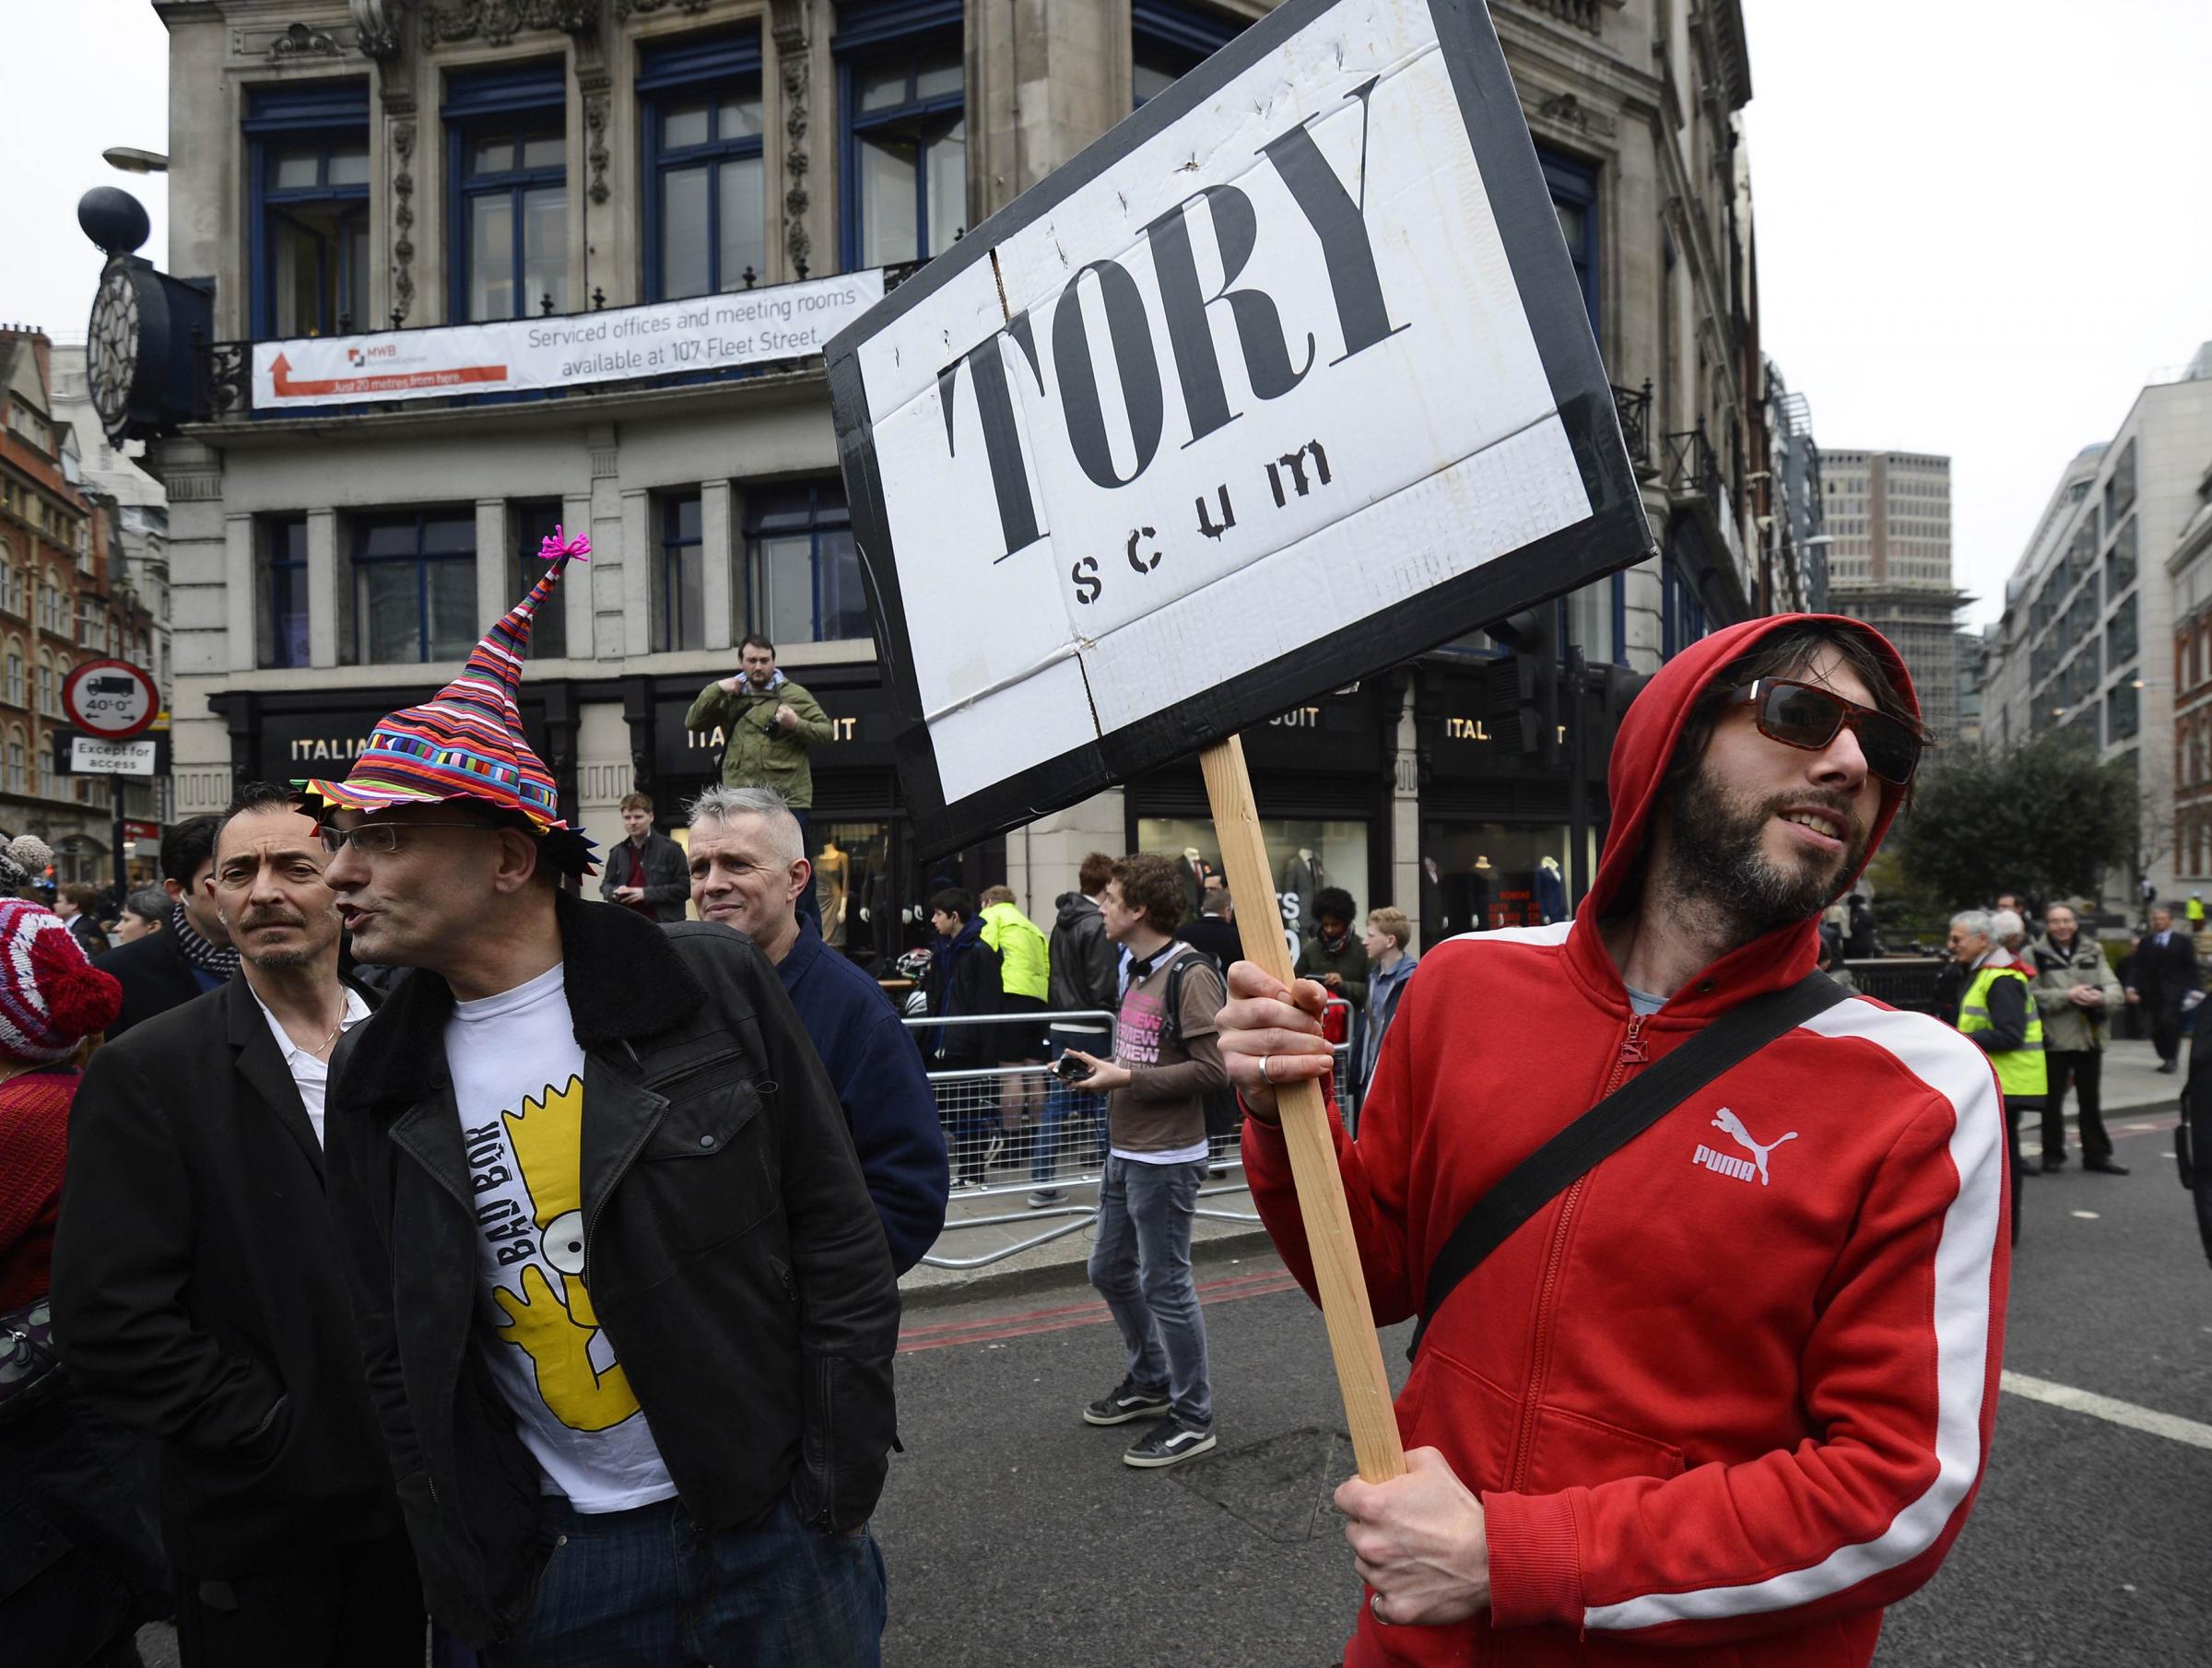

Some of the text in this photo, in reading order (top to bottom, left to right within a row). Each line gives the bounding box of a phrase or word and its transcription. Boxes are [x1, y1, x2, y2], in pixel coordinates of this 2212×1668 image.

[528, 289, 856, 348] Serviced offices and meeting rooms
[936, 74, 1412, 564] TORY
[367, 346, 396, 358] MWB
[562, 326, 822, 377] available at 107 Fleet Street.
[331, 381, 355, 394] Just
[357, 379, 369, 392] 20
[371, 377, 408, 391] metres
[410, 374, 435, 387] from
[1071, 439, 1333, 605] scum
[1447, 718, 1491, 740] ITAL
[78, 743, 127, 757] Except
[131, 745, 150, 757] for
[89, 759, 136, 769] access
[1692, 1144, 1757, 1183] PUMA
[476, 1199, 536, 1267] BAD
